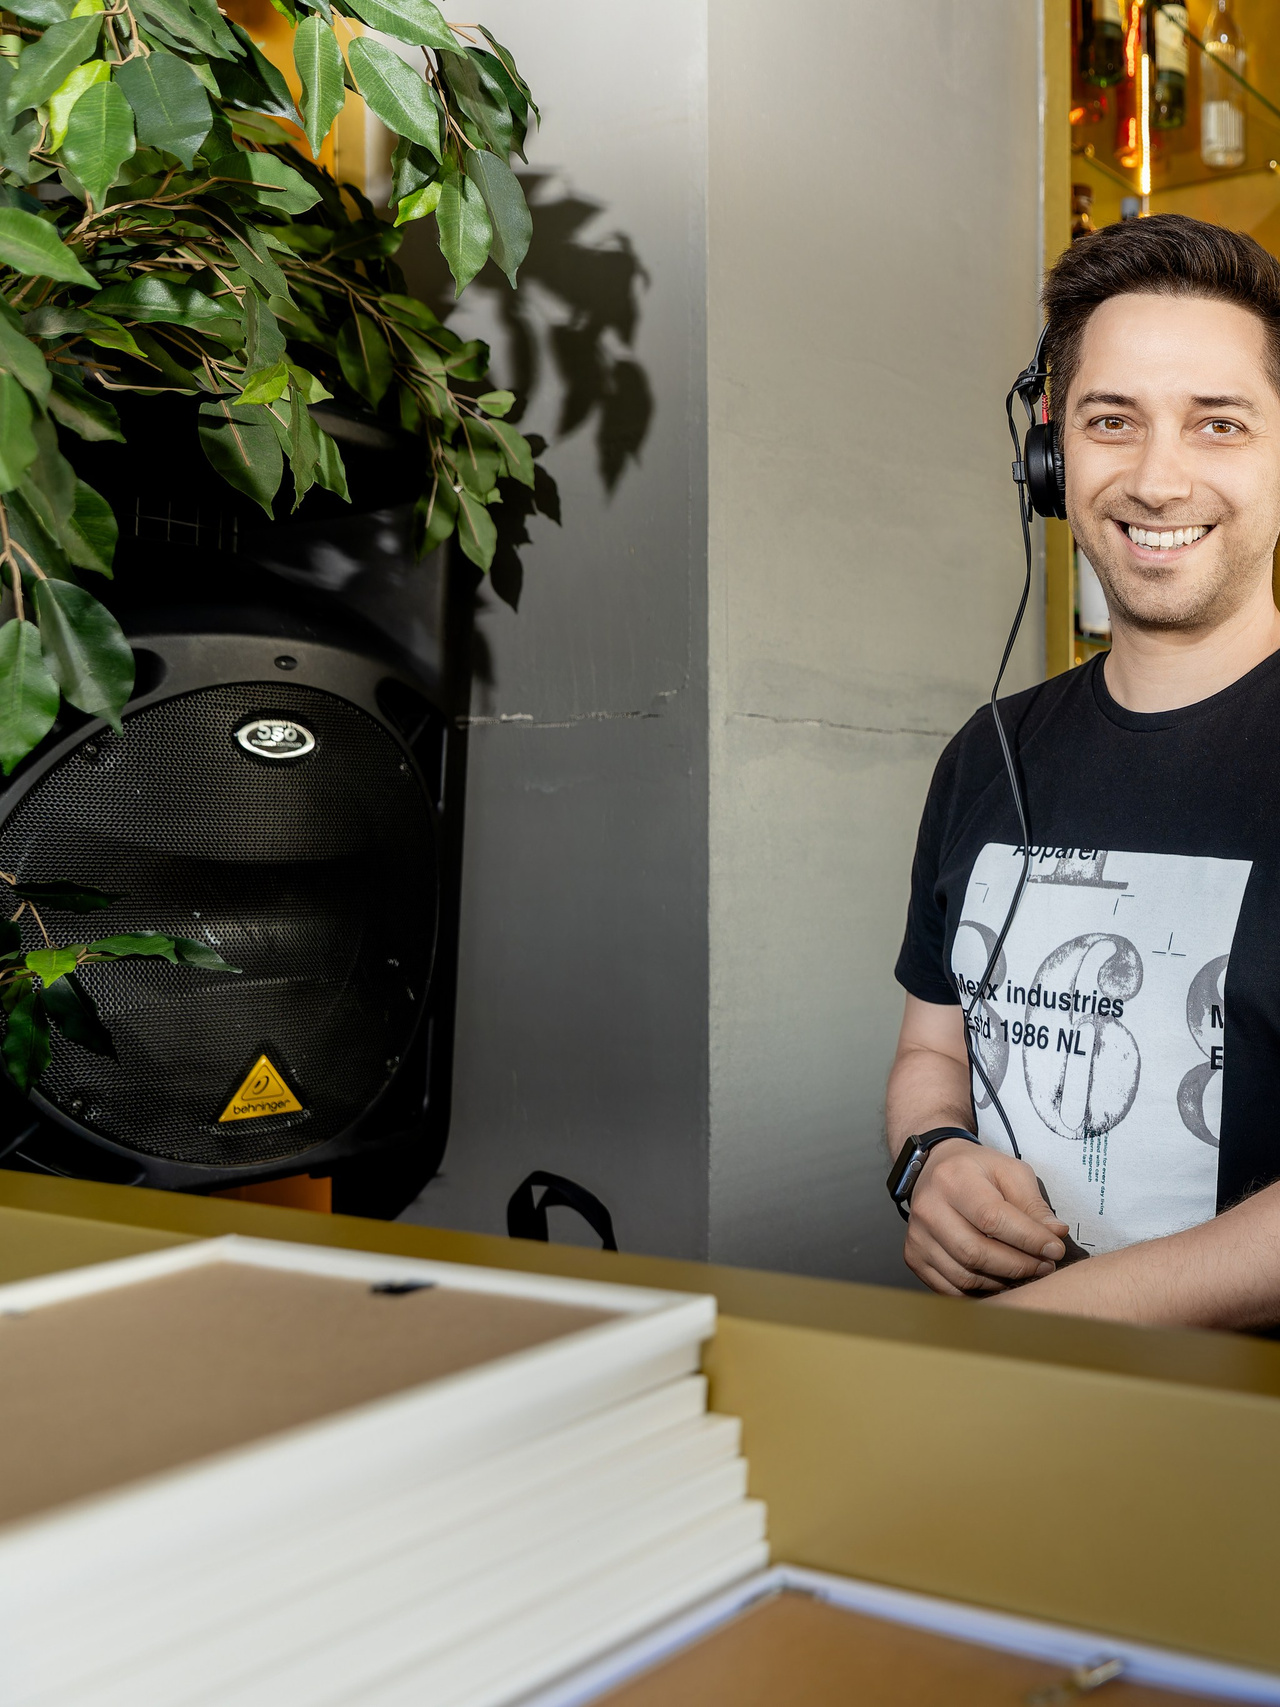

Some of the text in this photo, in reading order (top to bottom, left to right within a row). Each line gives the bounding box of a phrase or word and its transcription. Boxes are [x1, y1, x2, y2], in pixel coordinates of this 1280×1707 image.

[1006, 979, 1124, 1019] industries
[1000, 1019, 1050, 1050] 1986
[1056, 1027, 1087, 1057] NL
[233, 1099, 291, 1115] behringer
